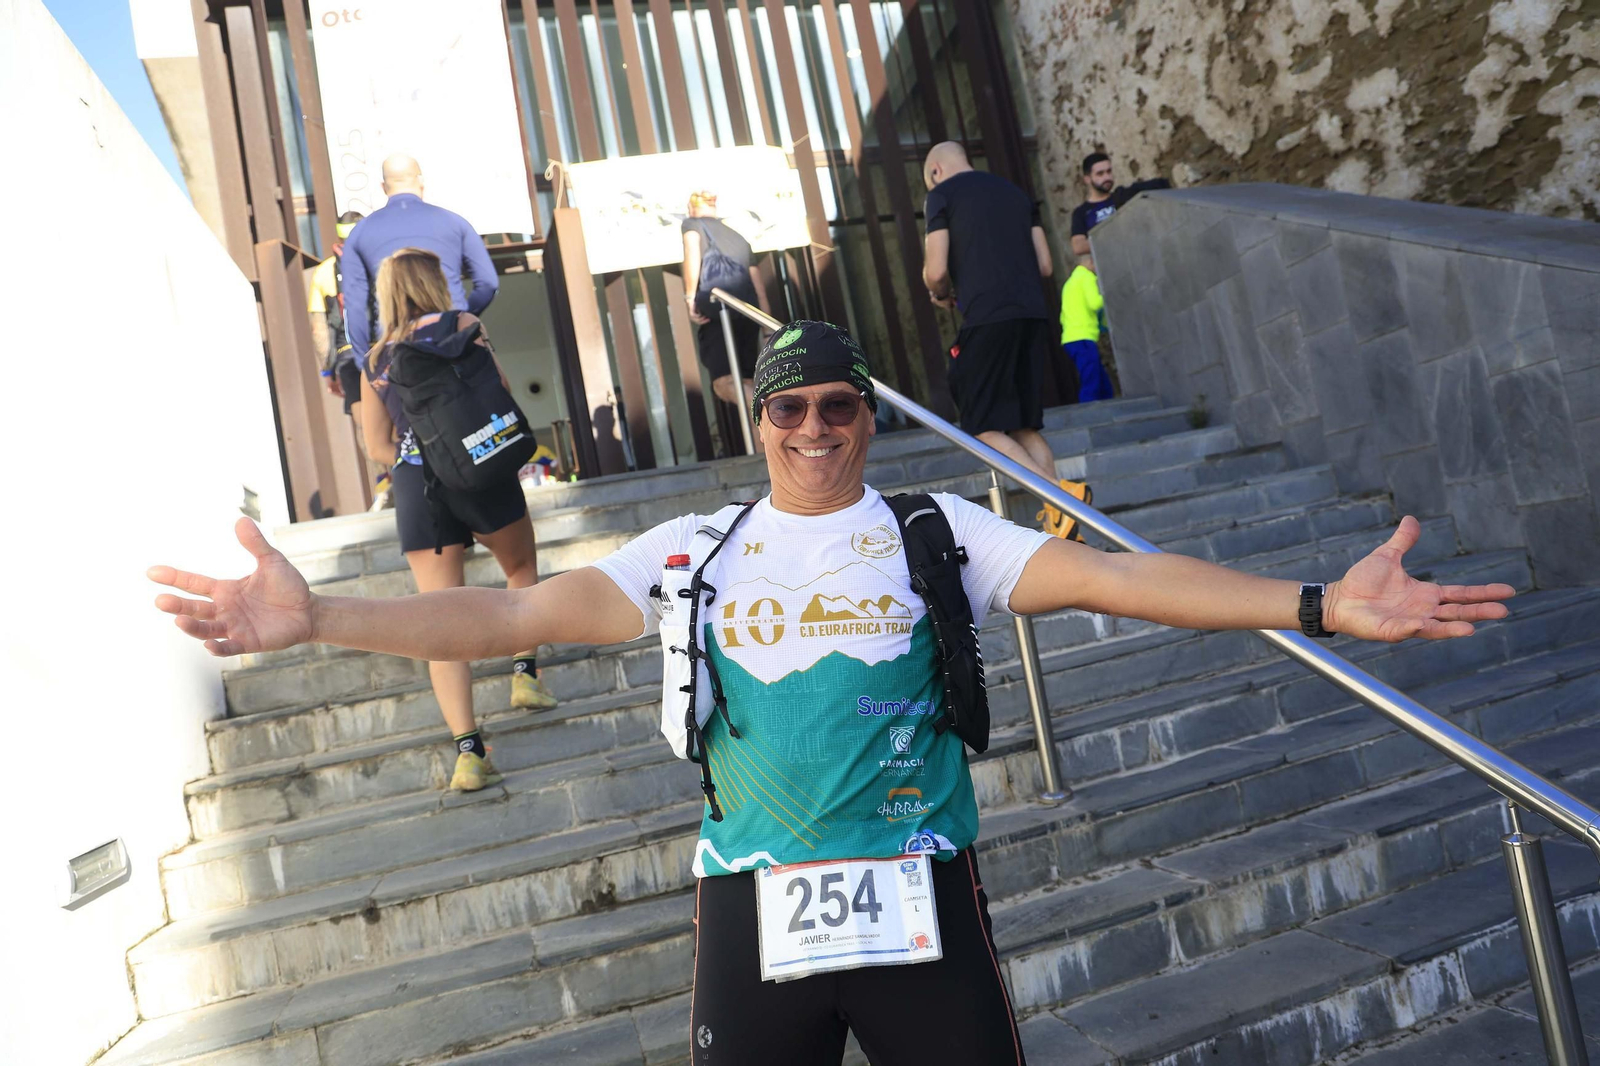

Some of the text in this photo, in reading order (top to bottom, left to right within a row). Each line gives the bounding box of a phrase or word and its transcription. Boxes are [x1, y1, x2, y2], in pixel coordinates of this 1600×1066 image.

[759, 347, 807, 371] ALGATOCÍN
[468, 439, 495, 460] 70.3
[720, 598, 785, 648] 10
[723, 617, 785, 626] ANIVERSARIO
[885, 622, 911, 635] TRAIL
[879, 758, 925, 768] FARMACIA
[785, 869, 883, 933] 254
[914, 904, 920, 912] L
[798, 933, 831, 946] JAVIER
